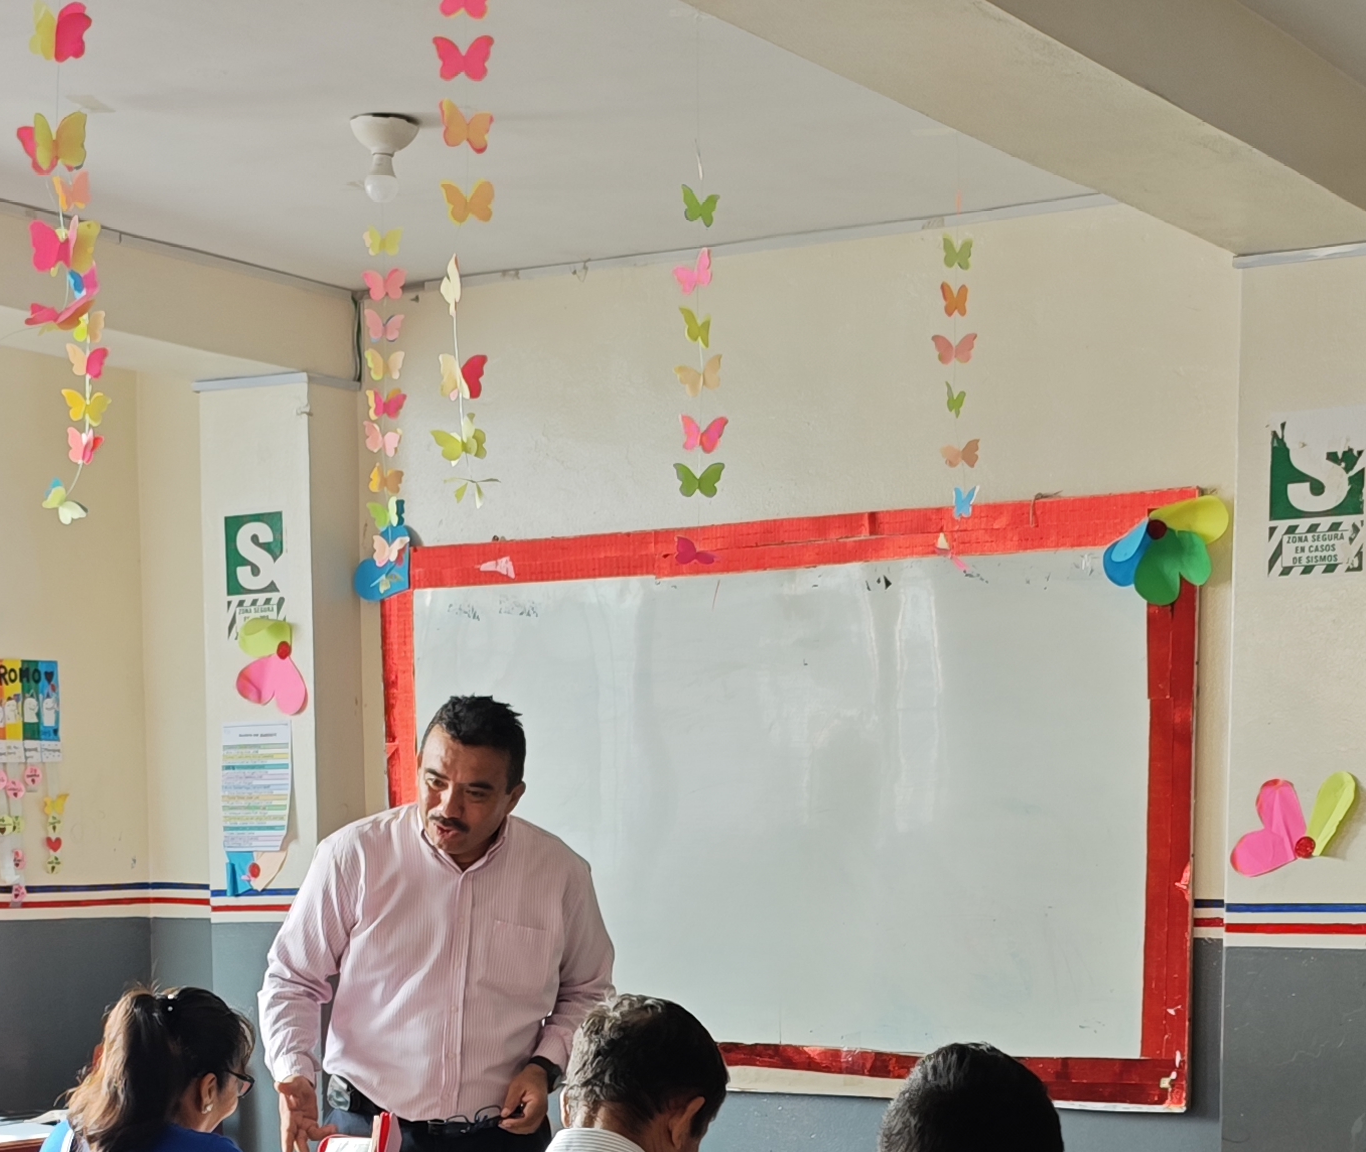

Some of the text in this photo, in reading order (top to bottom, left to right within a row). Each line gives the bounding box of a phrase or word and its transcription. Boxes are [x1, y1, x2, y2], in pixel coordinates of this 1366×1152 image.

[1286, 532, 1345, 544] ZONA SEGURA
[1295, 543, 1336, 554] EN CASOS
[236, 521, 276, 591] S
[1292, 554, 1338, 565] DE SISMOS
